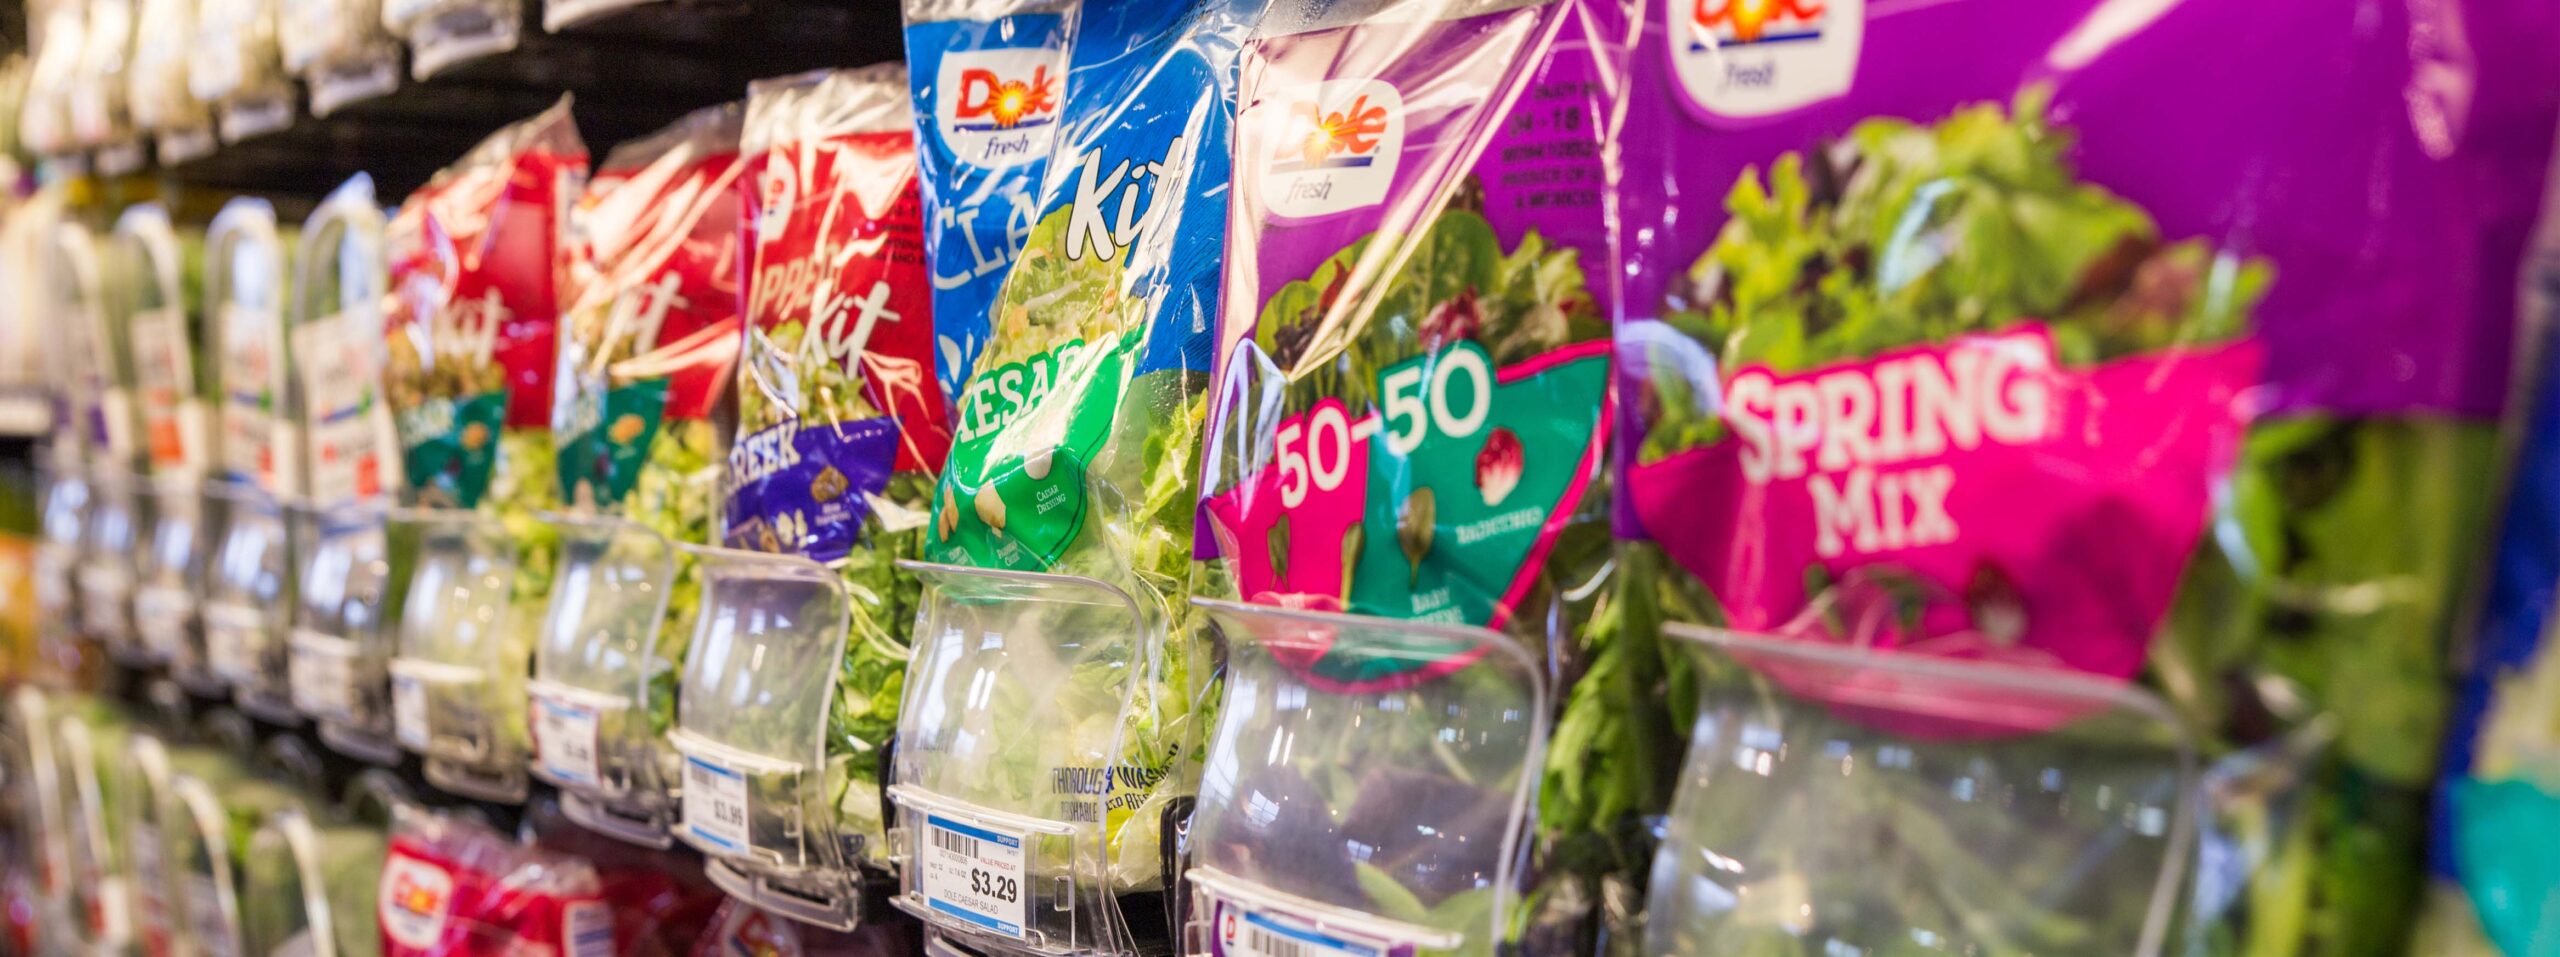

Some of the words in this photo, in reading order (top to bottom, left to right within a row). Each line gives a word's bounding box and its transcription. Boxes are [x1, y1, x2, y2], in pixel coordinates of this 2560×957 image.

[1273, 94, 1388, 162] Dole
[984, 133, 1030, 160] fresh
[1066, 136, 1184, 266] Kit
[1286, 173, 1332, 204] fresh
[798, 279, 901, 382] Kit
[1727, 333, 2047, 484] SPRING
[1276, 347, 1491, 509] 50-50
[997, 836, 1018, 848] SUPPORT
[994, 860, 1010, 871] PRICED
[943, 888, 958, 902] DOLE
[957, 893, 979, 909] CAESAR
[979, 900, 999, 915] SALAD
[971, 867, 1017, 903] $3.29
[997, 922, 1018, 935] SUPPORT
